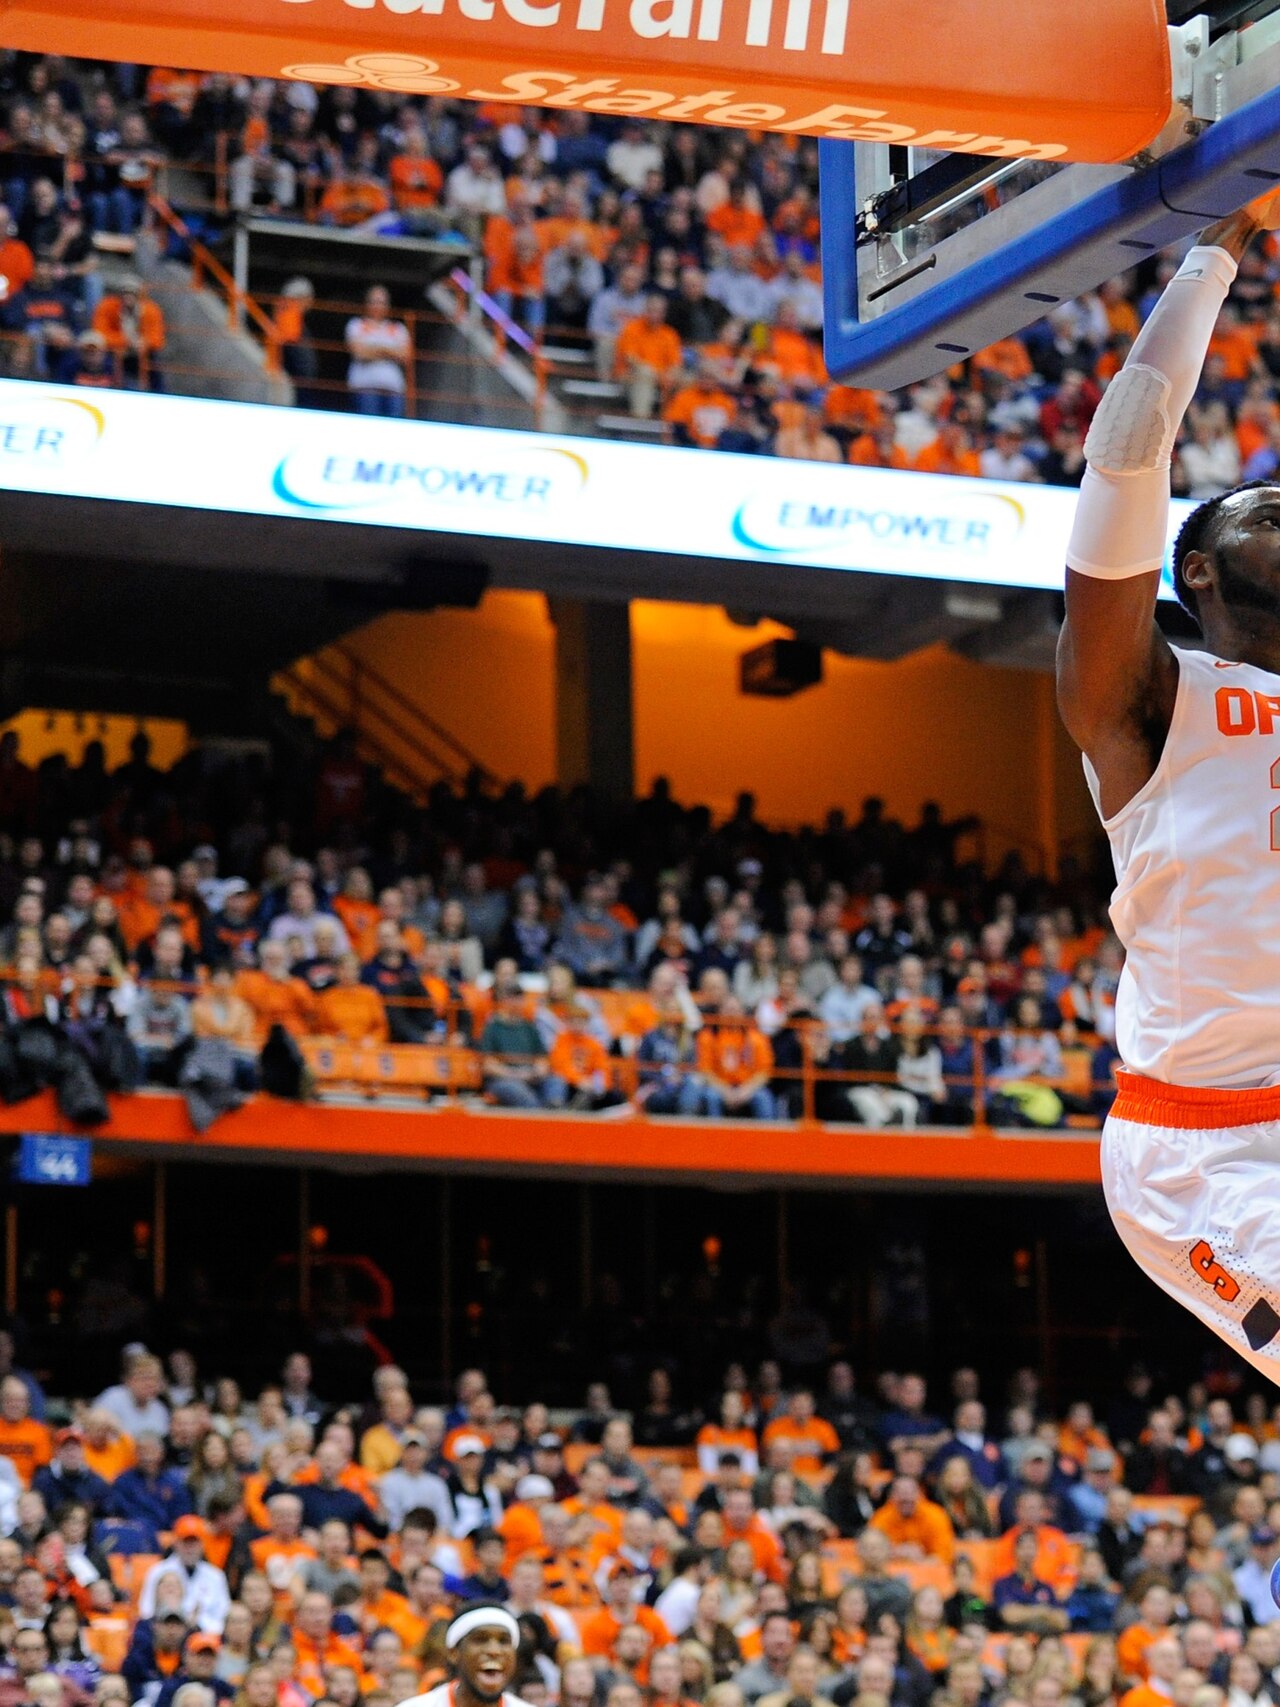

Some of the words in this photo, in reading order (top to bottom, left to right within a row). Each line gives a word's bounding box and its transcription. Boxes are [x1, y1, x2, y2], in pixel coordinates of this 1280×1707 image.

[467, 70, 786, 125] State
[769, 103, 1068, 161] Farm
[321, 455, 554, 502] EMPOWER
[777, 501, 992, 546] EMPOWER
